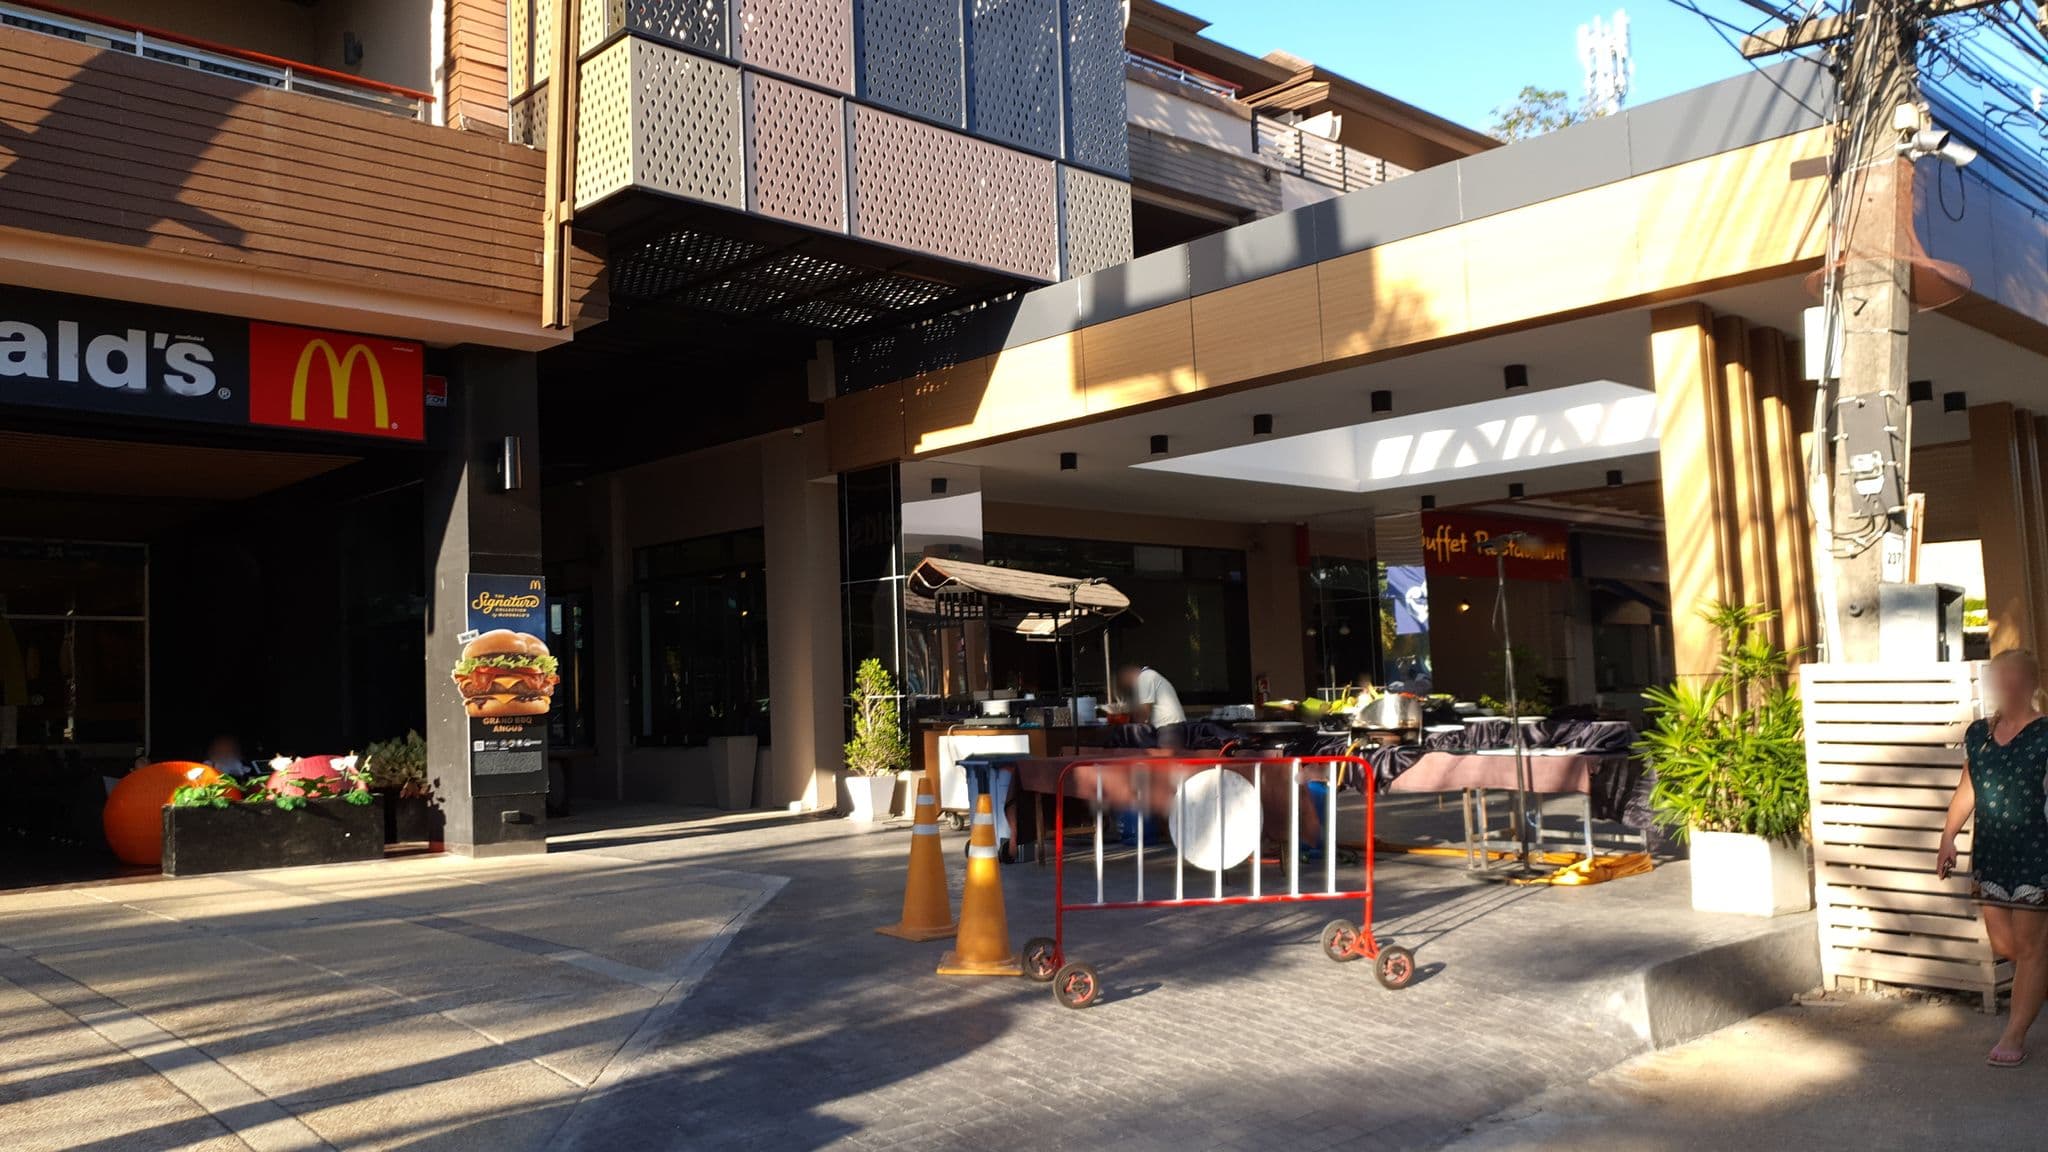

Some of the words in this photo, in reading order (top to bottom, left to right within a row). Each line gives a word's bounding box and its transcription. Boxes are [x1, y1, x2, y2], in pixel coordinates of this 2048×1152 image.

[471, 591, 540, 614] Signature
[482, 717, 513, 726] GRAND
[492, 725, 524, 733] ANGUS
